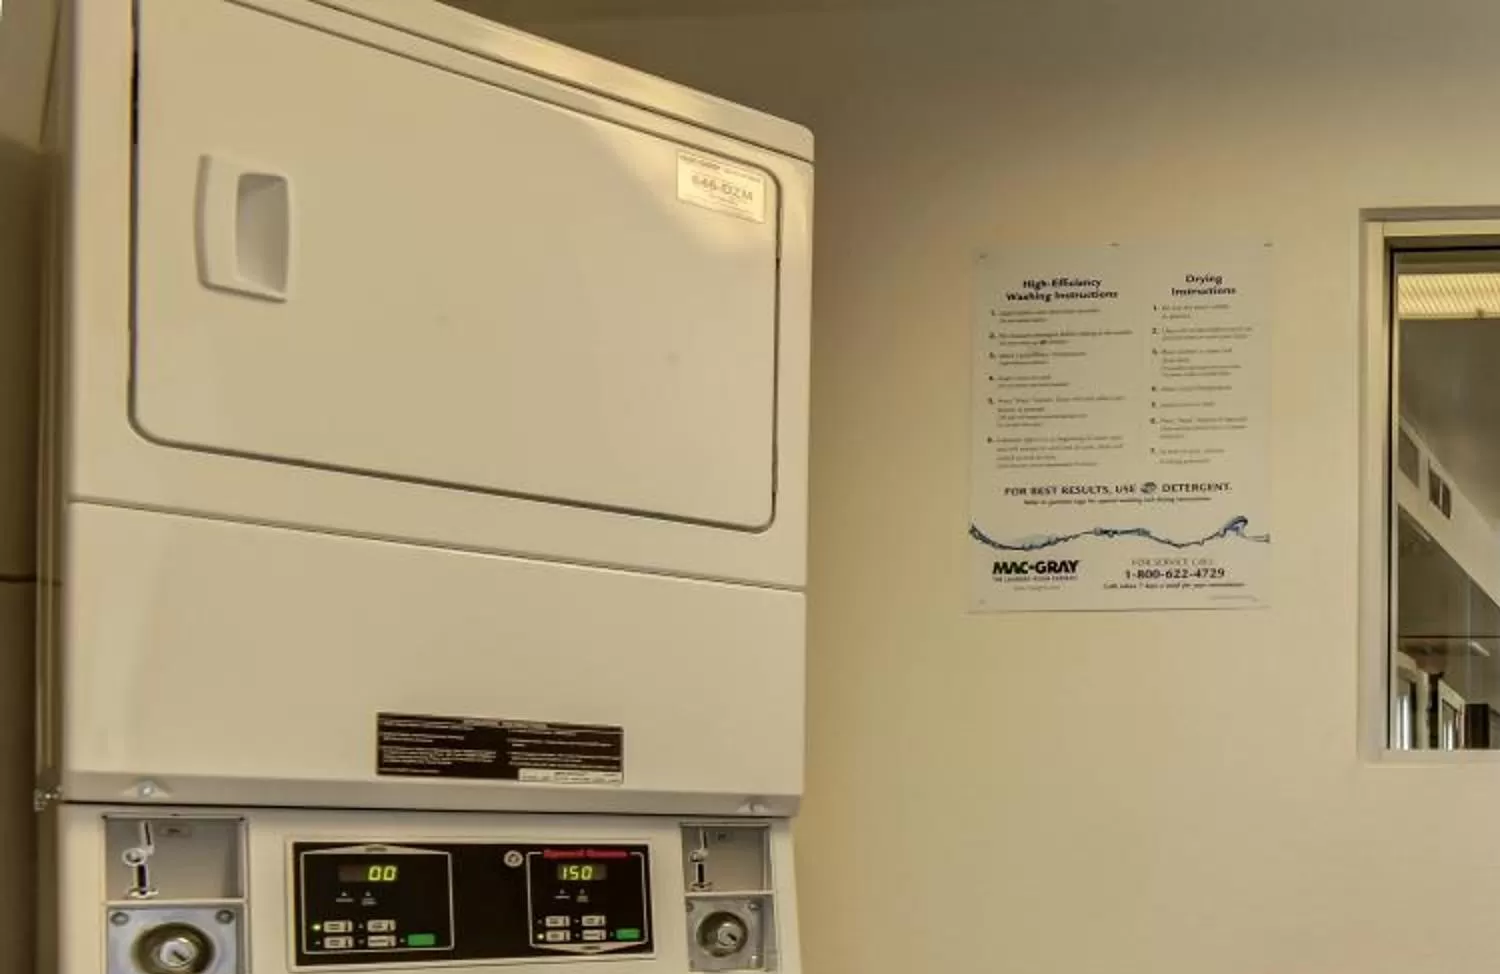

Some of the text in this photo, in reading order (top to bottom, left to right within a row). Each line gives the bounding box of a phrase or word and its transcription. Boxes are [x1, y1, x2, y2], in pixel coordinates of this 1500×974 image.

[1185, 274, 1222, 285] Drying
[1006, 290, 1118, 302] Washing Instructions
[1171, 287, 1236, 296] Instructions
[1004, 487, 1027, 496] FOR
[1030, 486, 1057, 495] BEST
[1115, 484, 1136, 494] USE
[1161, 482, 1233, 493] DETERGENT.
[1125, 568, 1225, 579] 1-800-622-4729
